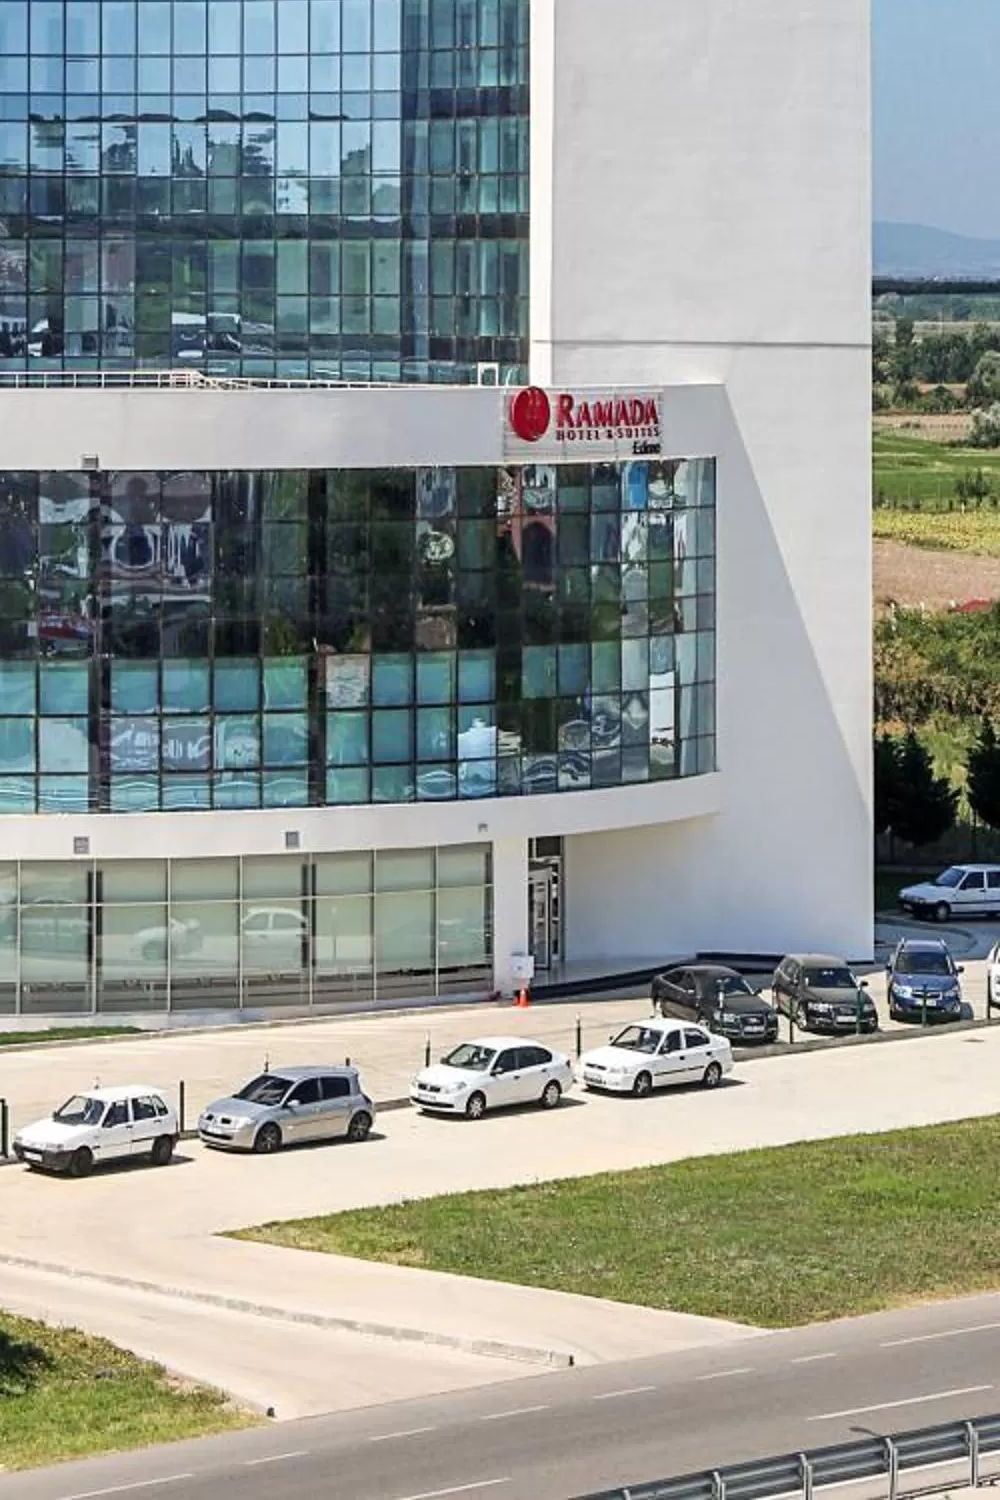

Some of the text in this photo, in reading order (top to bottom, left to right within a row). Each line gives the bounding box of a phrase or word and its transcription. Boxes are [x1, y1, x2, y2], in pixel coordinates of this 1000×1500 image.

[556, 393, 659, 428] RAMADA
[556, 428, 600, 441] HOTEL
[617, 426, 660, 440] SUITES
